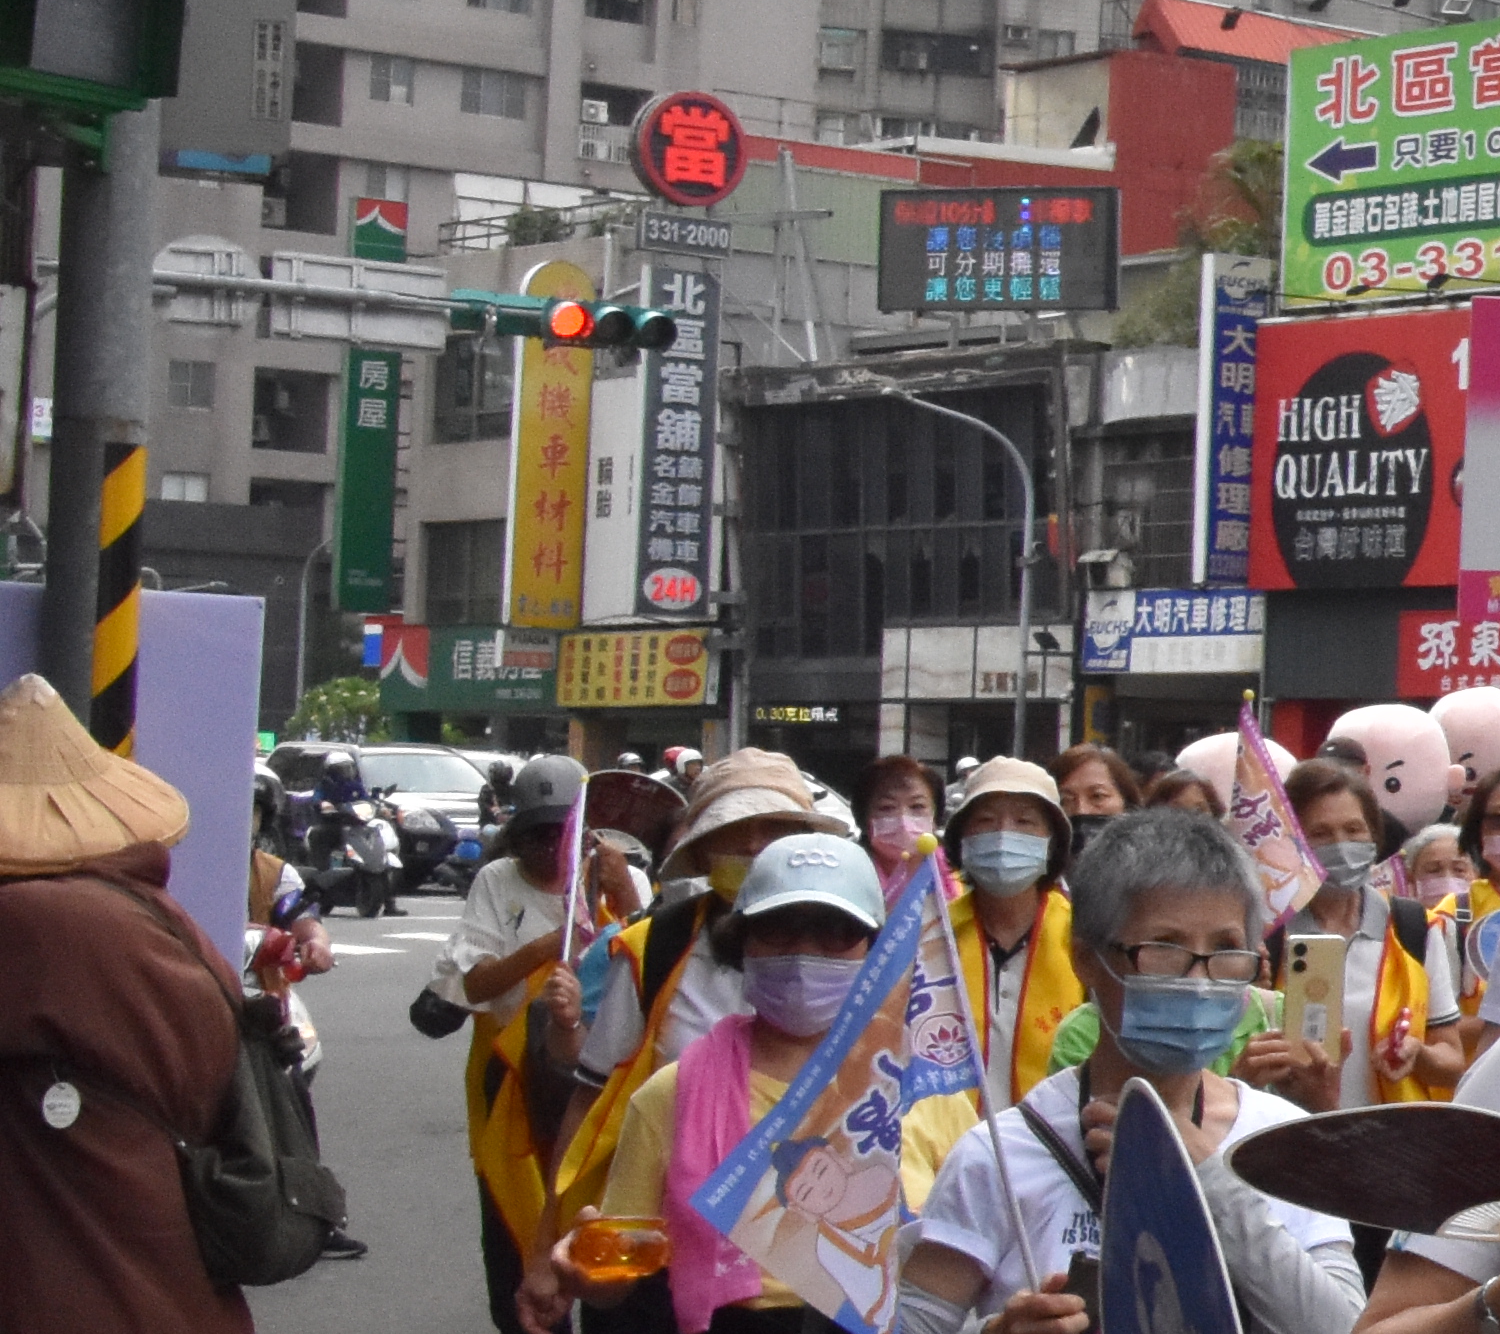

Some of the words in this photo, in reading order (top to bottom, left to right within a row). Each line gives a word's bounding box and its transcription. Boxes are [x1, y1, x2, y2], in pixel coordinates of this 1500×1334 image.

[660, 103, 731, 188] 當
[647, 219, 731, 250] 331-2000
[357, 360, 389, 429] 房屋
[1277, 393, 1363, 443] HIGH
[1274, 447, 1429, 501] QUALITY
[651, 576, 697, 604] 24H
